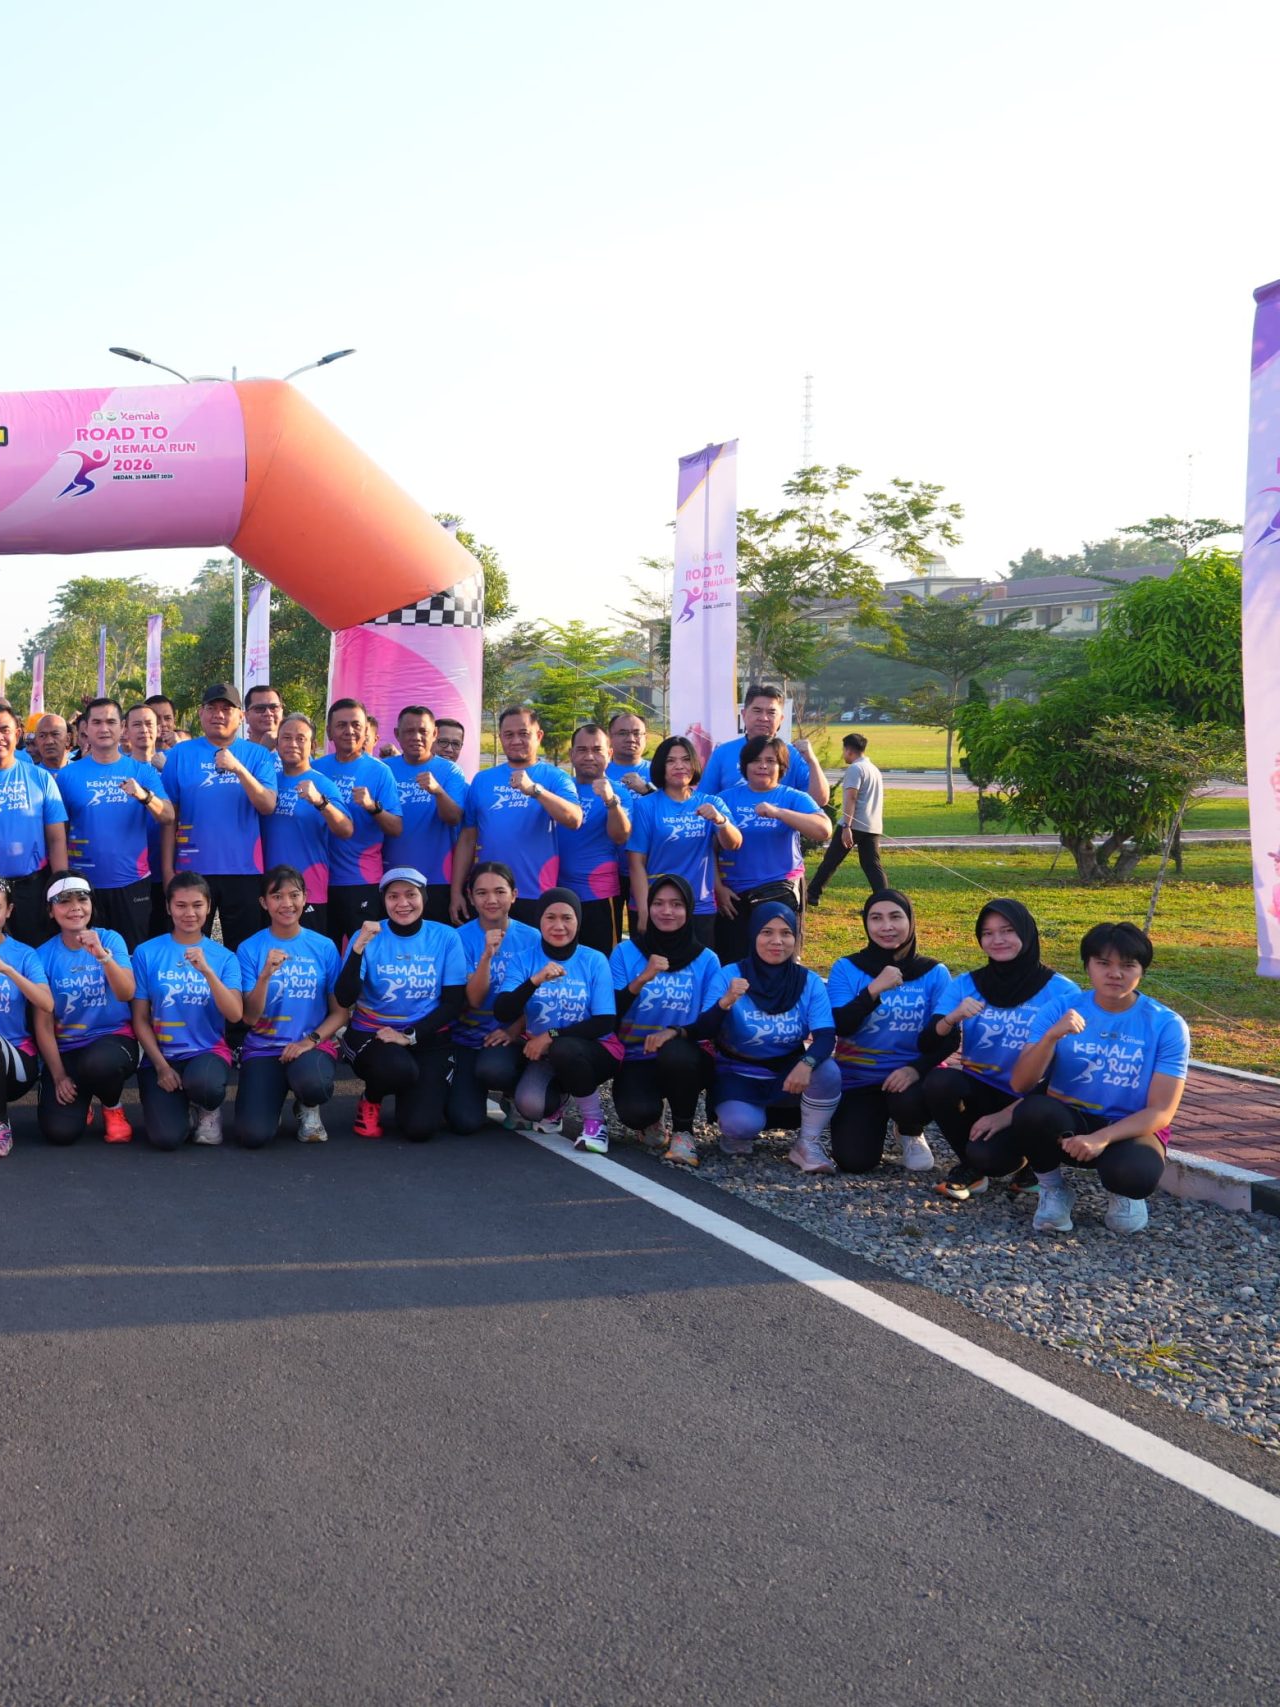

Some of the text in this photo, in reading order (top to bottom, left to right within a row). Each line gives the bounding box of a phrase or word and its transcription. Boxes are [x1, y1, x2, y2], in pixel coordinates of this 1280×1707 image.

[120, 411, 160, 421] Kemala
[76, 426, 168, 442] ROAD TO
[113, 443, 196, 454] KEMALA RUN
[113, 458, 153, 471] 2026
[703, 591, 718, 602] 026
[86, 780, 119, 788] KEMAL
[218, 777, 240, 785] 2026
[396, 781, 419, 790] KEMA
[8, 793, 27, 802] RUN
[106, 794, 128, 803] 2026
[508, 799, 529, 808] 2026
[279, 800, 296, 811] RUN
[663, 815, 705, 824] KEMALA
[754, 820, 777, 828] 2026
[685, 822, 705, 832] RUN
[376, 963, 436, 976] KEMALA
[55, 974, 104, 988] KEMALA
[291, 976, 316, 989] RUN
[409, 976, 436, 989] RUN
[186, 982, 210, 995] RUN
[288, 987, 315, 1000] 2026
[405, 988, 436, 1001] 2026
[666, 988, 692, 1002] RUN
[182, 995, 208, 1007] 2026
[559, 999, 585, 1012] RUN
[880, 995, 925, 1010] MALA
[556, 1011, 584, 1023] 2026
[892, 1008, 924, 1021] RUN
[775, 1022, 802, 1035] RUN
[888, 1021, 923, 1032] 2026
[1001, 1037, 1025, 1050] 202
[1073, 1040, 1144, 1062] KEMALA
[1108, 1057, 1142, 1076] RUN
[1102, 1070, 1139, 1089] 2026
